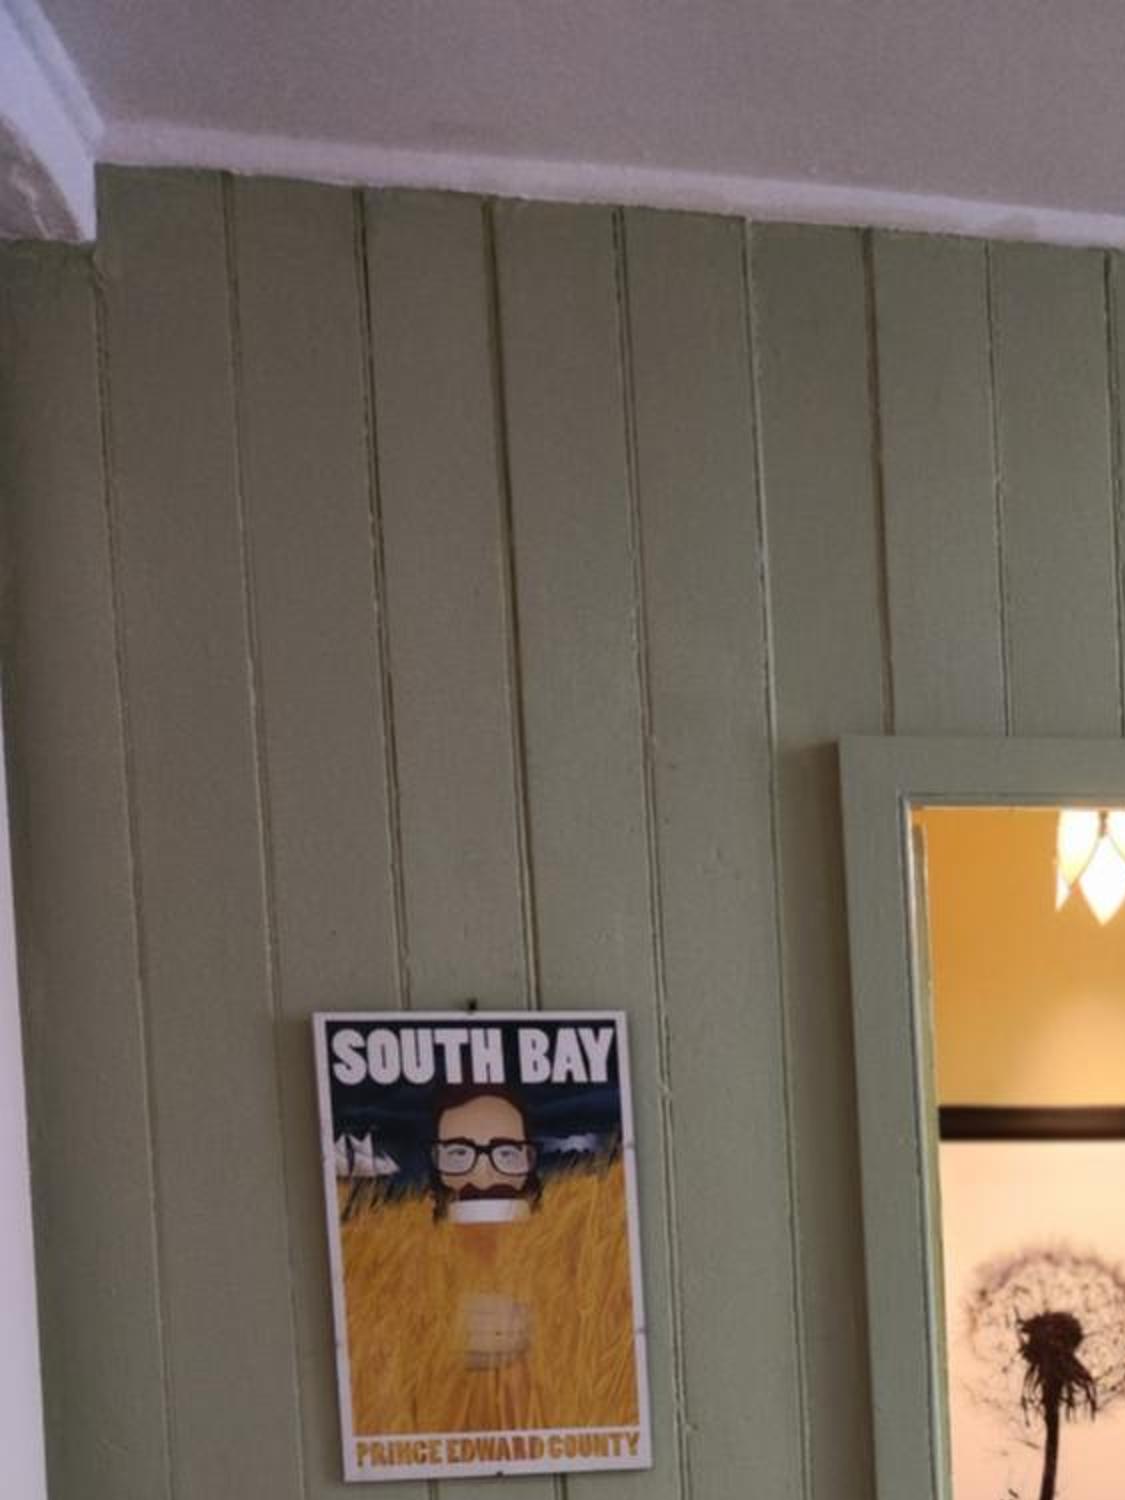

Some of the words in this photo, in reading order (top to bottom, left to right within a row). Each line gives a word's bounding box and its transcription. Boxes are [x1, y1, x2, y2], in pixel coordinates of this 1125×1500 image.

[332, 1028, 504, 1085] SOUTH
[518, 1028, 615, 1084] BAY
[356, 1439, 442, 1468] PRINCE
[447, 1435, 545, 1464] EDWARD
[549, 1432, 640, 1459] COUNTY
